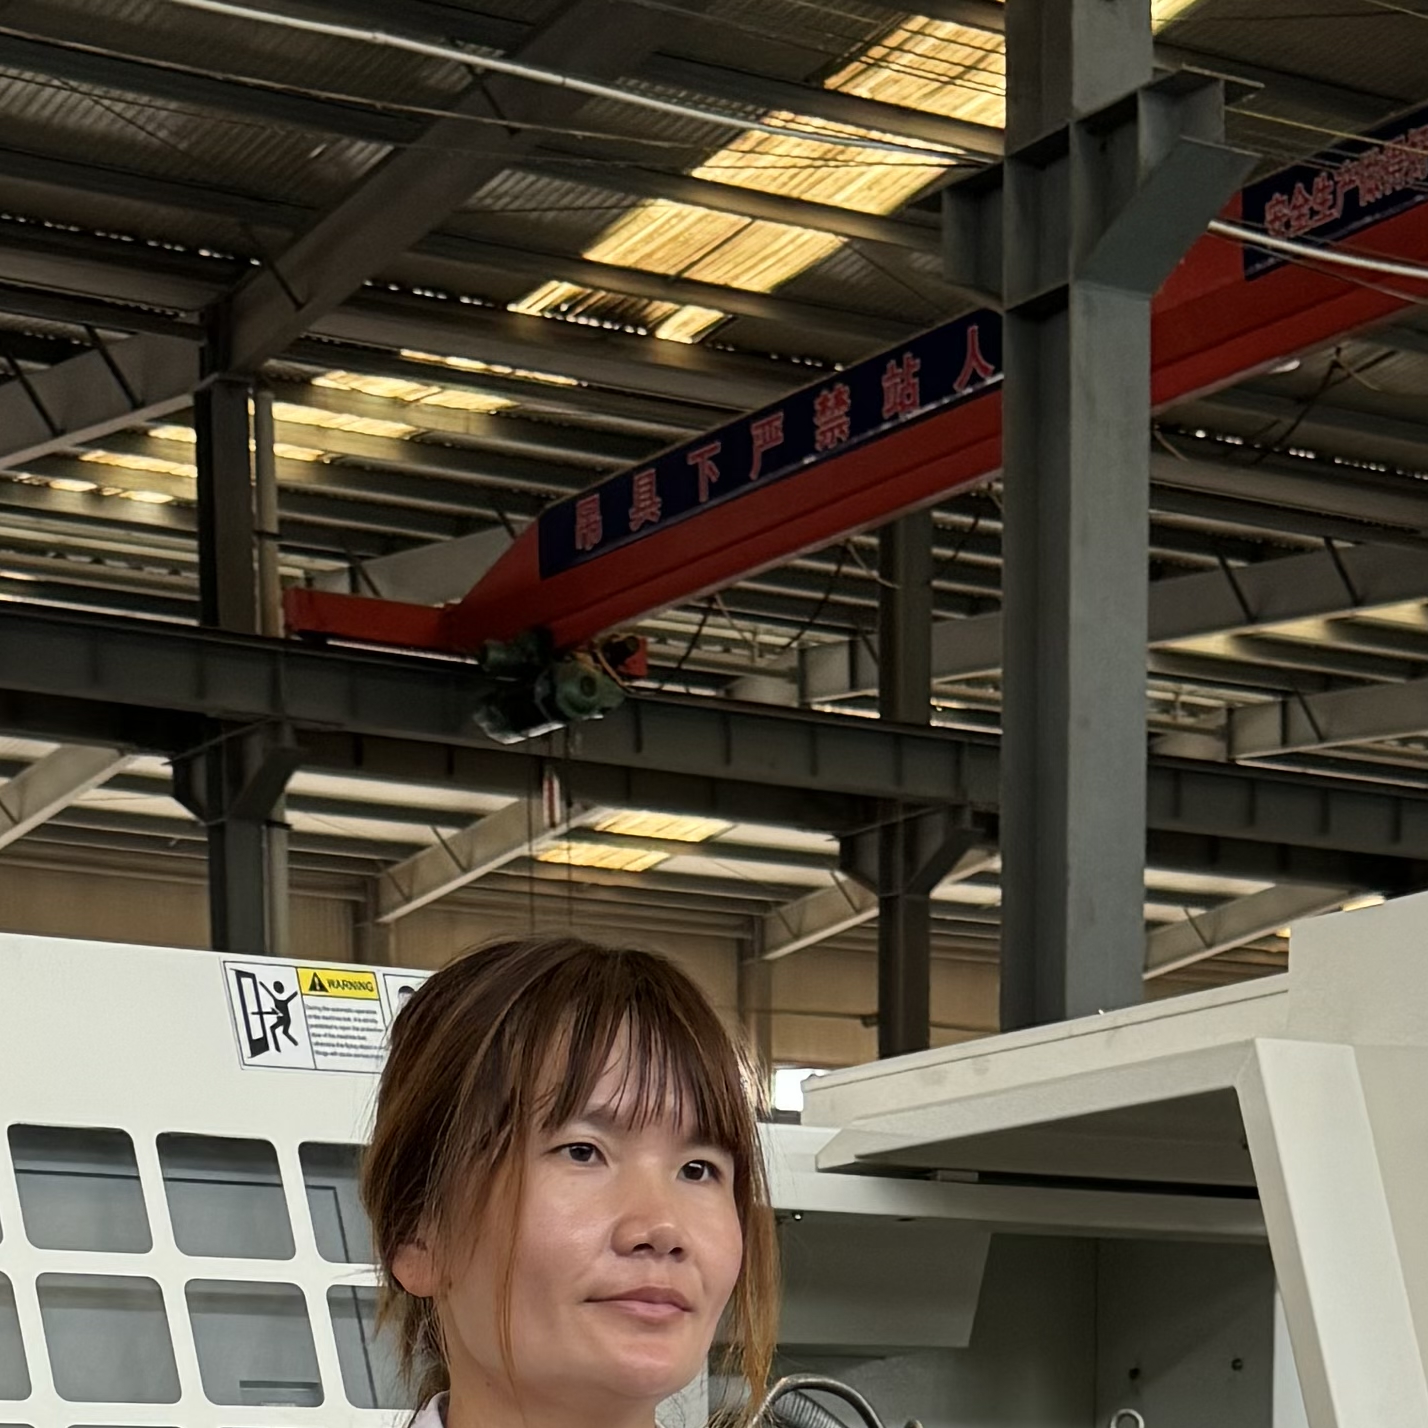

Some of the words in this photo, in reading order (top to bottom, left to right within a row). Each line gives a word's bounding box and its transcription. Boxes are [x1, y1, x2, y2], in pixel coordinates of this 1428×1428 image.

[574, 324, 995, 551] 吊具下严禁站人
[326, 978, 375, 993] WARNING
